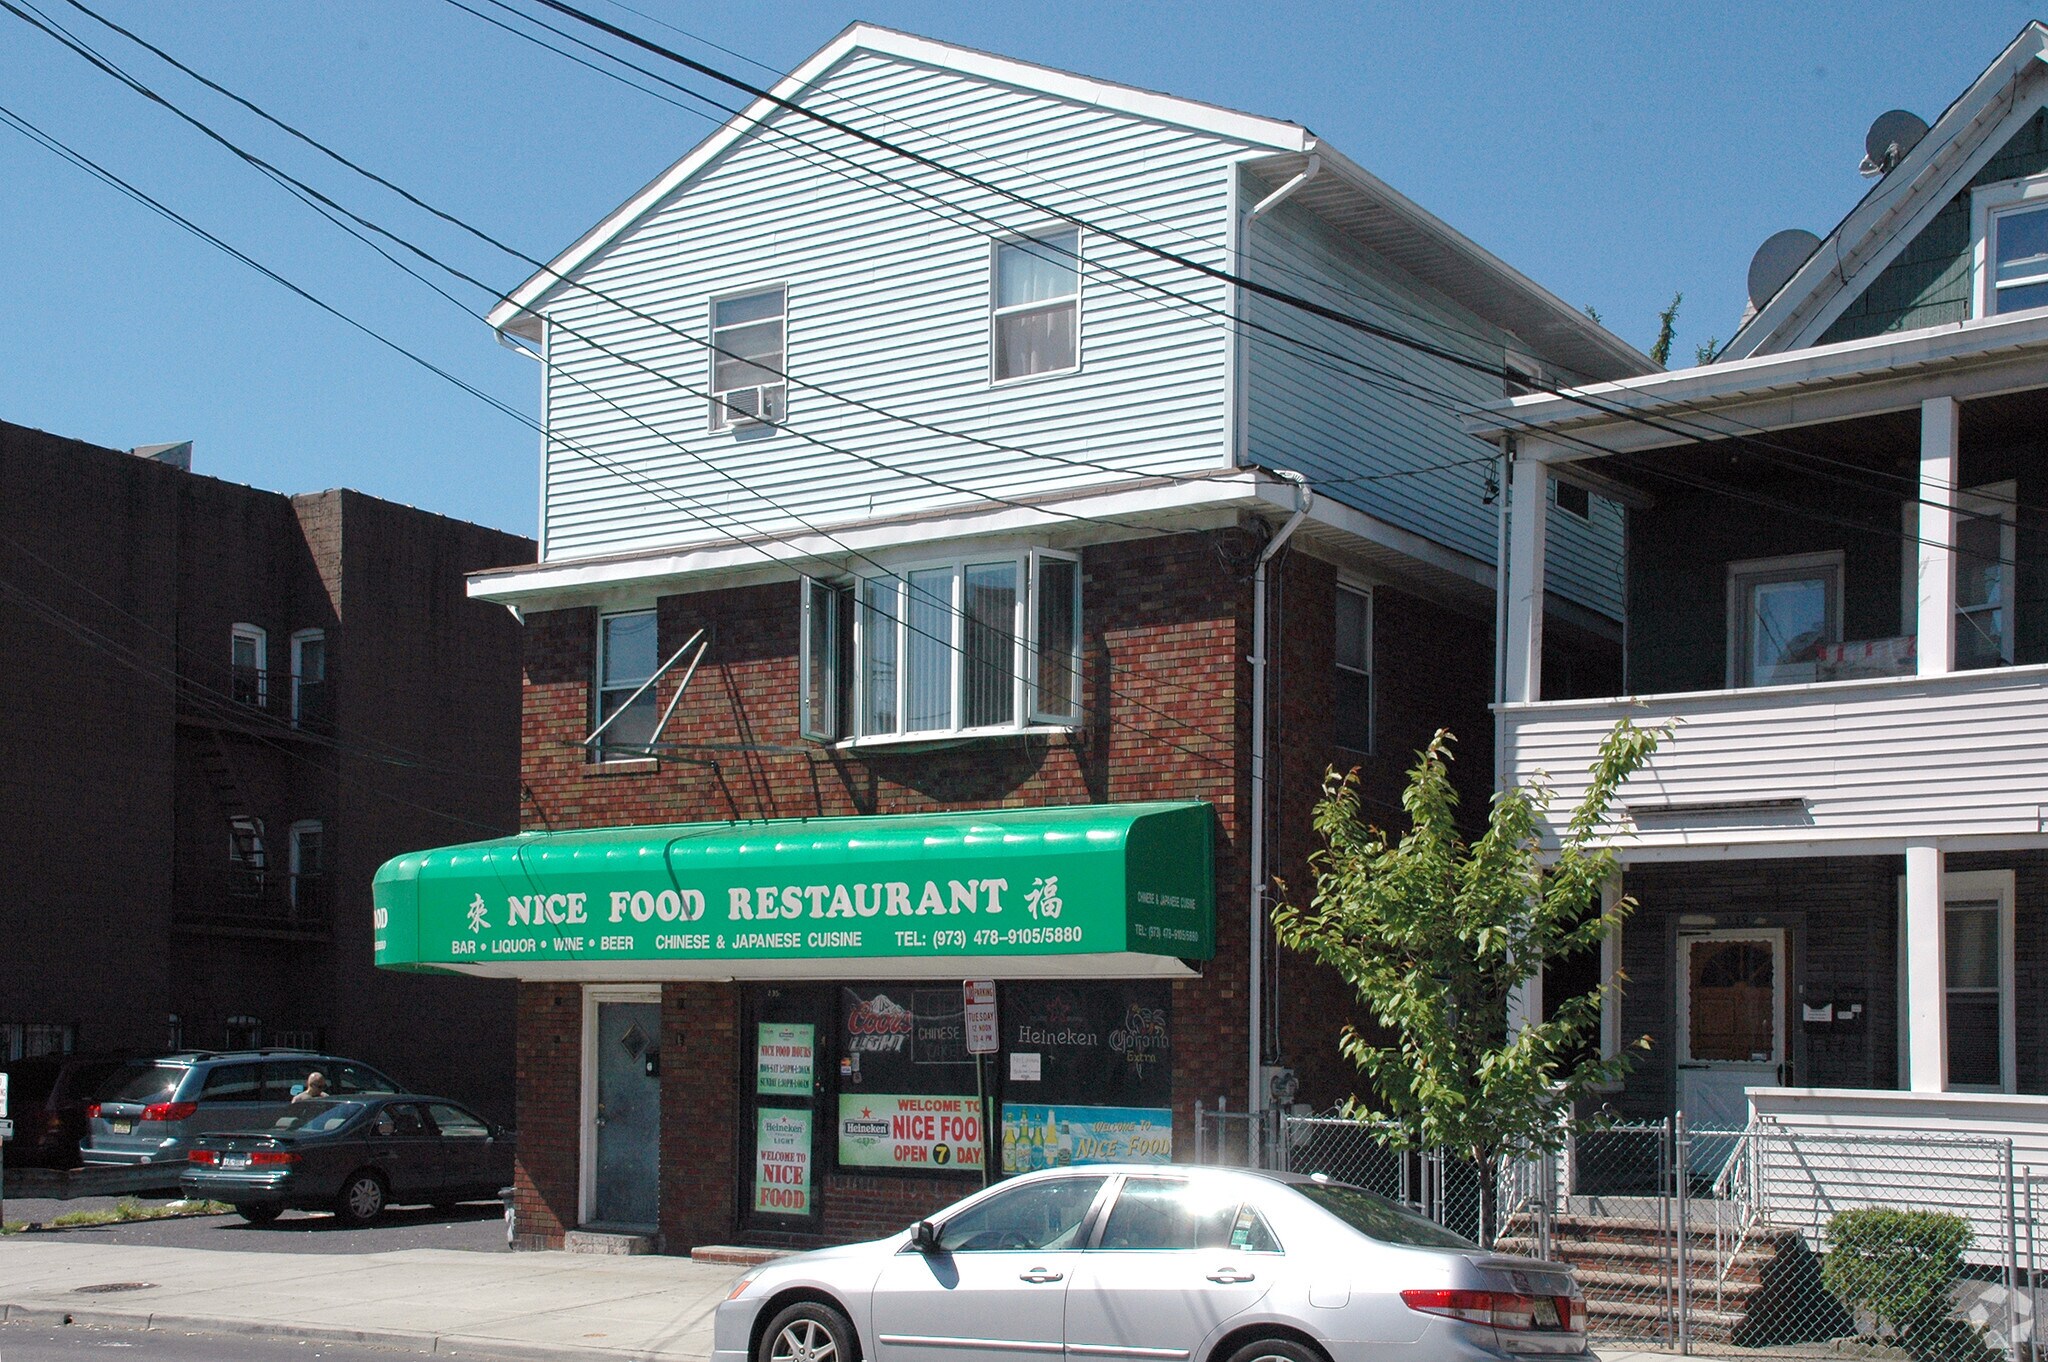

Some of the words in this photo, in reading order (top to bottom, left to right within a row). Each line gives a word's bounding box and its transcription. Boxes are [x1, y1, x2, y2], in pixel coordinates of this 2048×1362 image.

[507, 892, 588, 927] NICE
[608, 889, 706, 923] FOOD
[728, 877, 1008, 920] RESTAURANT
[1023, 876, 1063, 920] 福
[451, 940, 476, 954] BAR
[491, 939, 536, 953] LIQUOR
[553, 937, 584, 951] WINE
[600, 936, 634, 950] BEER
[655, 934, 710, 949] CHINESE
[716, 933, 726, 949] &
[732, 932, 801, 948] JAPANESE
[807, 931, 862, 947] CUISINE
[895, 930, 926, 947] TEL:
[933, 930, 967, 949] (973)
[973, 926, 1083, 945] 478-9105/5880
[848, 1000, 913, 1035] Coors
[968, 1012, 994, 1022] TUESDAY
[918, 1026, 960, 1040] CHINESE
[1018, 1025, 1099, 1047] Heineken
[1108, 1028, 1170, 1053] Corona
[849, 1034, 906, 1052] LIGHT
[1126, 1050, 1157, 1063] Extra
[897, 1099, 962, 1113] WELCOME
[766, 1122, 803, 1134] Heineken
[846, 1122, 887, 1134] Heineken
[892, 1114, 935, 1141] NICE
[1094, 1121, 1137, 1133] WELCOME
[774, 1137, 794, 1145] LIGHT
[1076, 1137, 1119, 1159] NICE
[1128, 1135, 1171, 1157] FOOD
[761, 1150, 794, 1163] WELCOME
[797, 1152, 806, 1163] TO
[894, 1144, 928, 1162] OPEN
[935, 1146, 948, 1163] 7
[763, 1163, 804, 1185] NICE
[760, 1187, 805, 1209] FOOD
